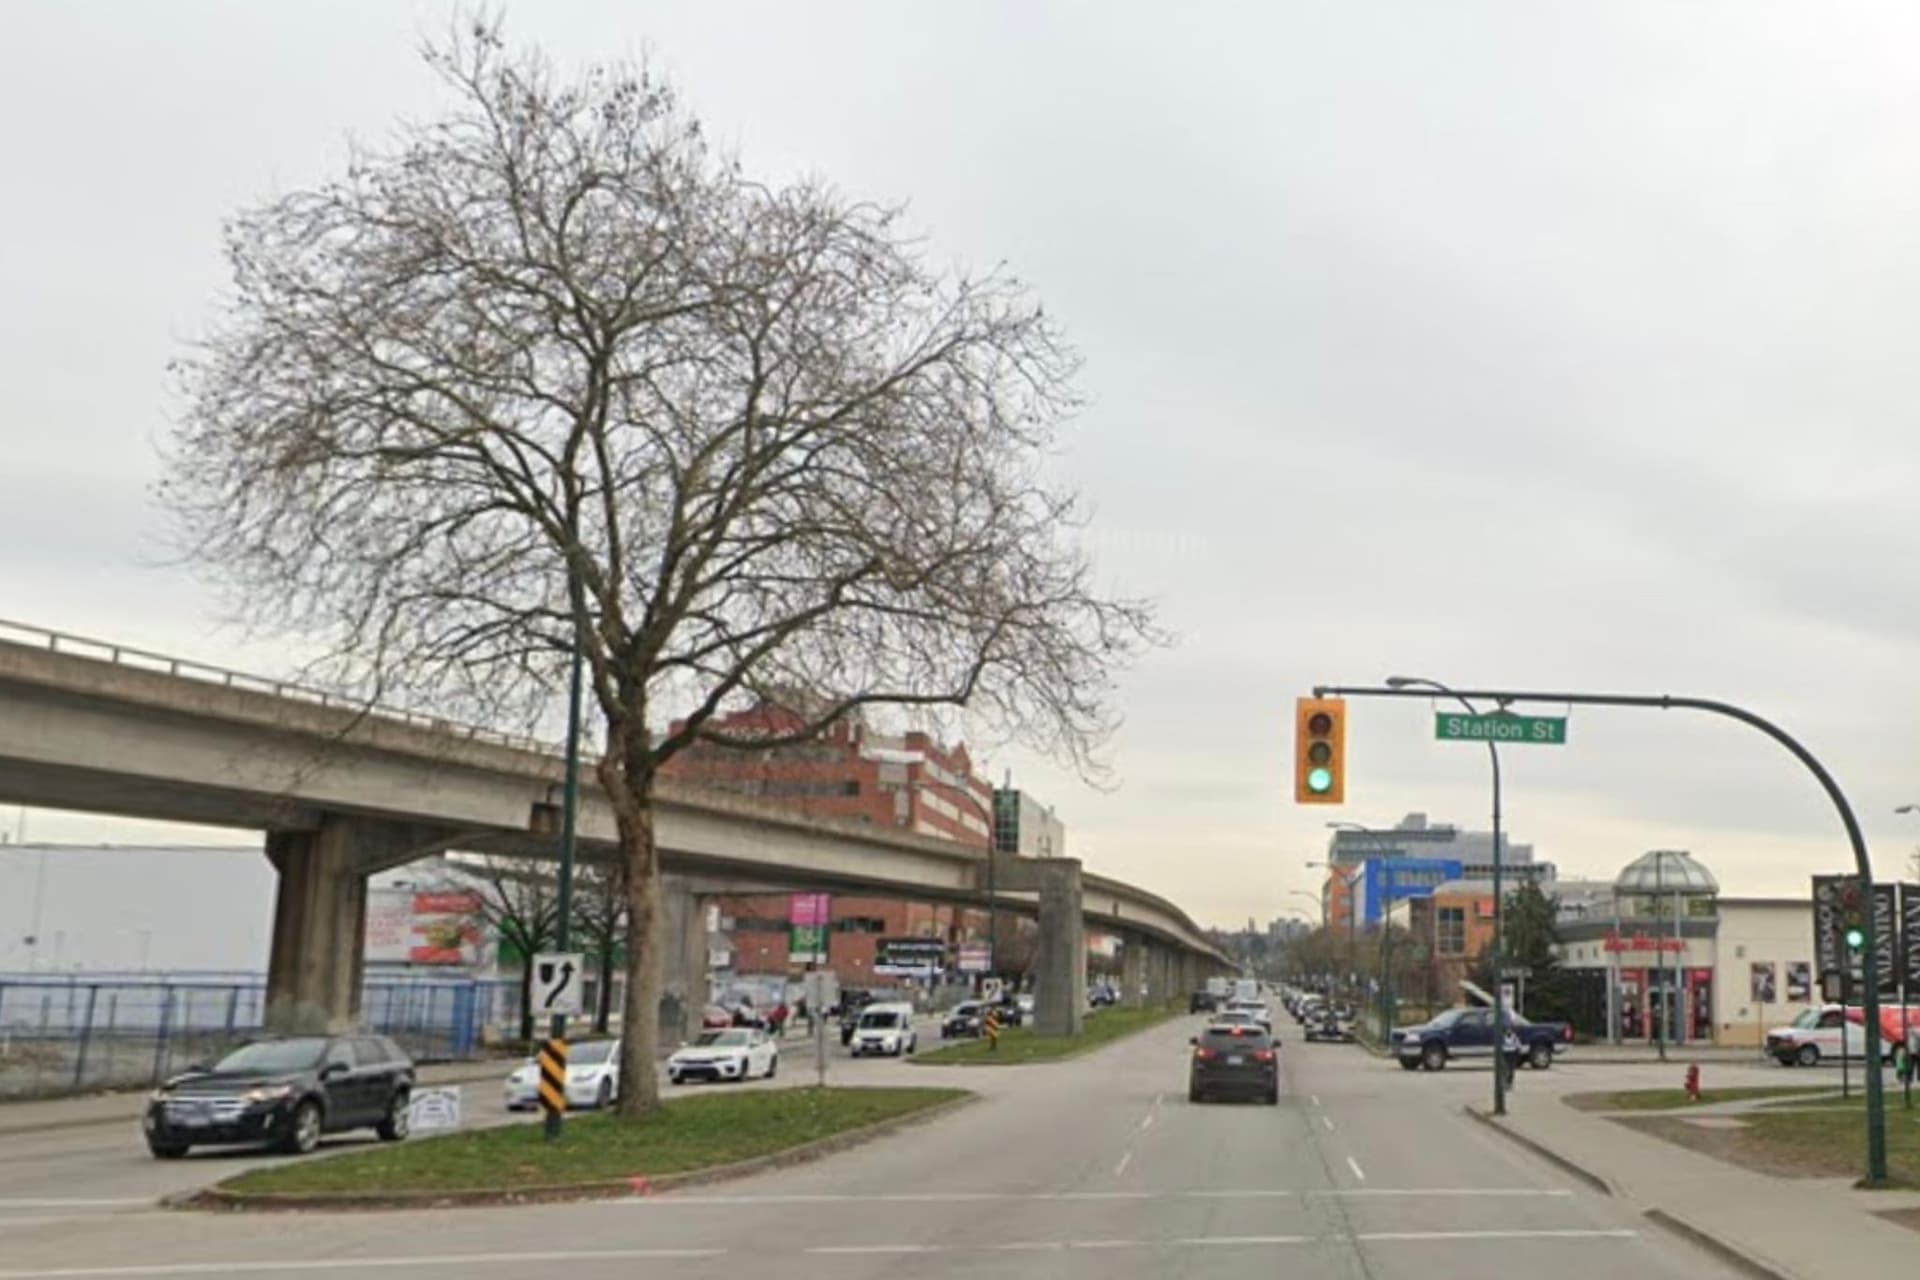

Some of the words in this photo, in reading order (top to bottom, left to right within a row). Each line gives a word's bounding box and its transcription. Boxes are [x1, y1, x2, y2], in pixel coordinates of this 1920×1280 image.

[1446, 717, 1523, 738] Station
[1532, 720, 1556, 739] St
[1873, 893, 1893, 985] VALENTINO
